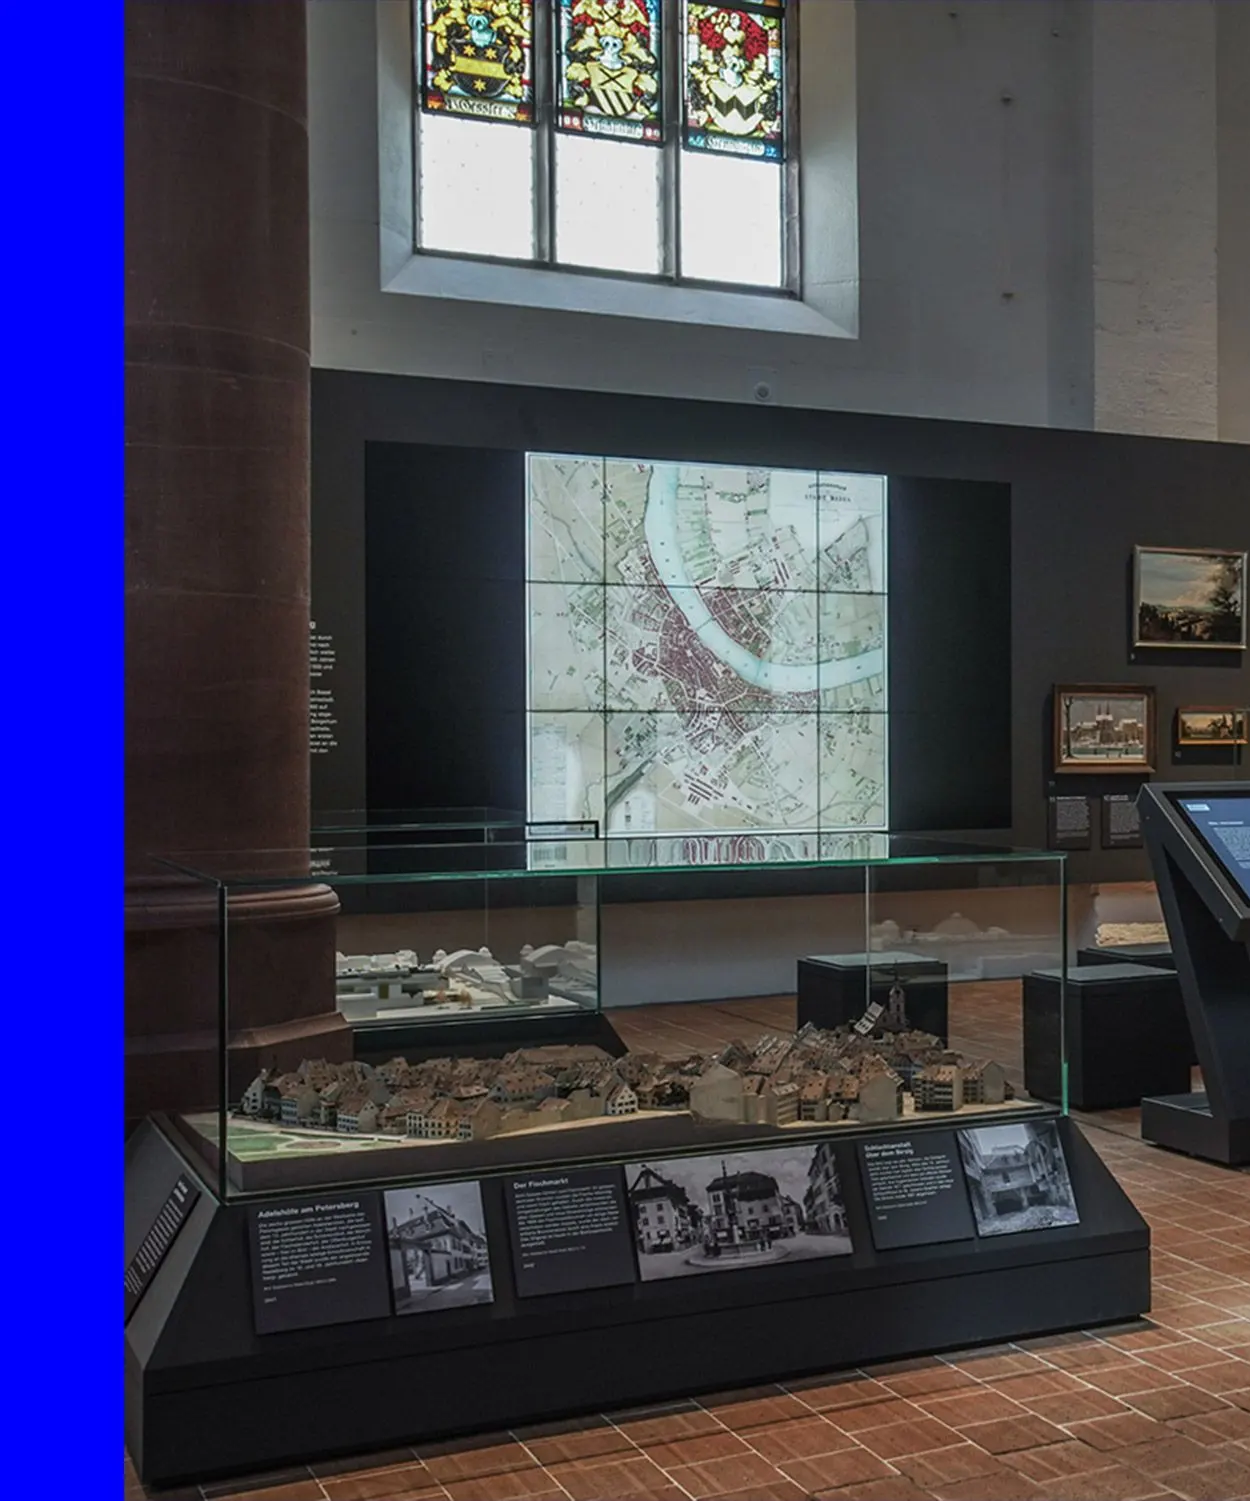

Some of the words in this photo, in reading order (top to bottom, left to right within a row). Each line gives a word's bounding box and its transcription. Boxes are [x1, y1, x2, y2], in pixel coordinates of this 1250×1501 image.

[513, 1181, 527, 1190] Der
[528, 1178, 569, 1188] Fischmarkt
[300, 1206, 314, 1214] am
[315, 1201, 360, 1212] Petersberg
